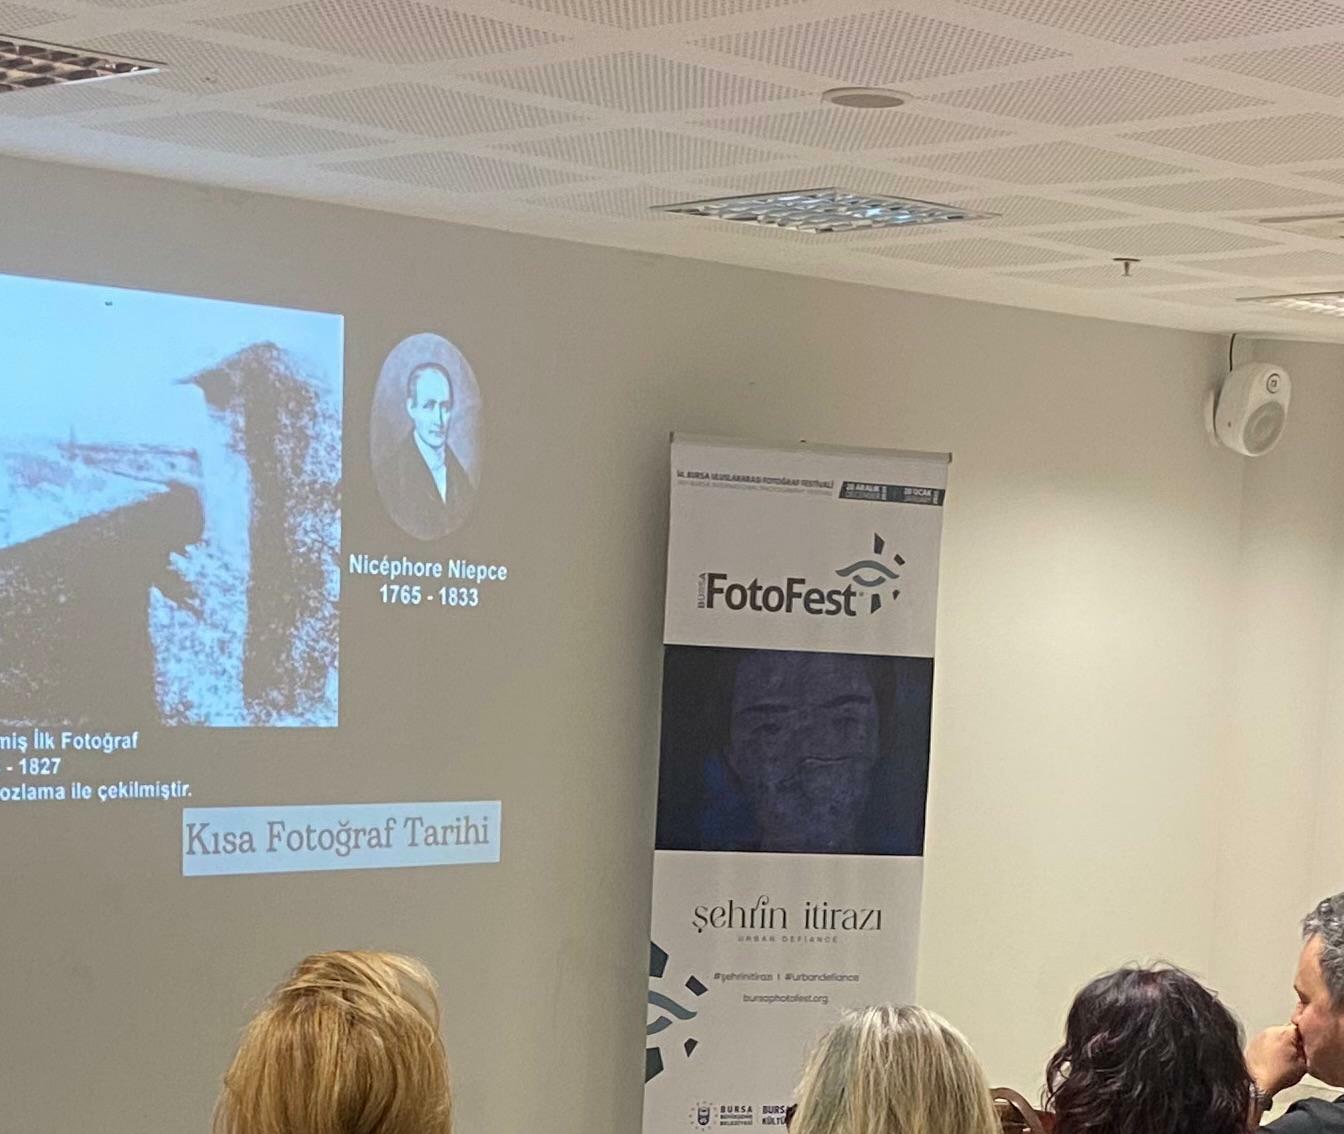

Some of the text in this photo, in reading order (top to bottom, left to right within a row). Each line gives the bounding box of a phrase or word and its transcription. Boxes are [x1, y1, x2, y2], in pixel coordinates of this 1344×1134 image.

[349, 553, 508, 584] Nicéphore Niepce
[380, 584, 422, 605] 1765
[439, 587, 479, 606] 1833
[706, 572, 857, 617] FotoFest
[34, 729, 55, 750] İlk
[61, 731, 139, 753] Fotoğraf
[19, 757, 62, 775] 1827
[71, 782, 92, 800] ile
[97, 780, 193, 802] çekilmiştir.
[185, 815, 490, 857] Kısa Fotoğraf Tarihi
[691, 894, 883, 934] şehrin itirazı
[738, 935, 839, 944] URBAN DEFIANCE
[720, 1105, 753, 1114] BURSA
[762, 1105, 786, 1115] BURS
[762, 1116, 787, 1126] KÜLTÜ
